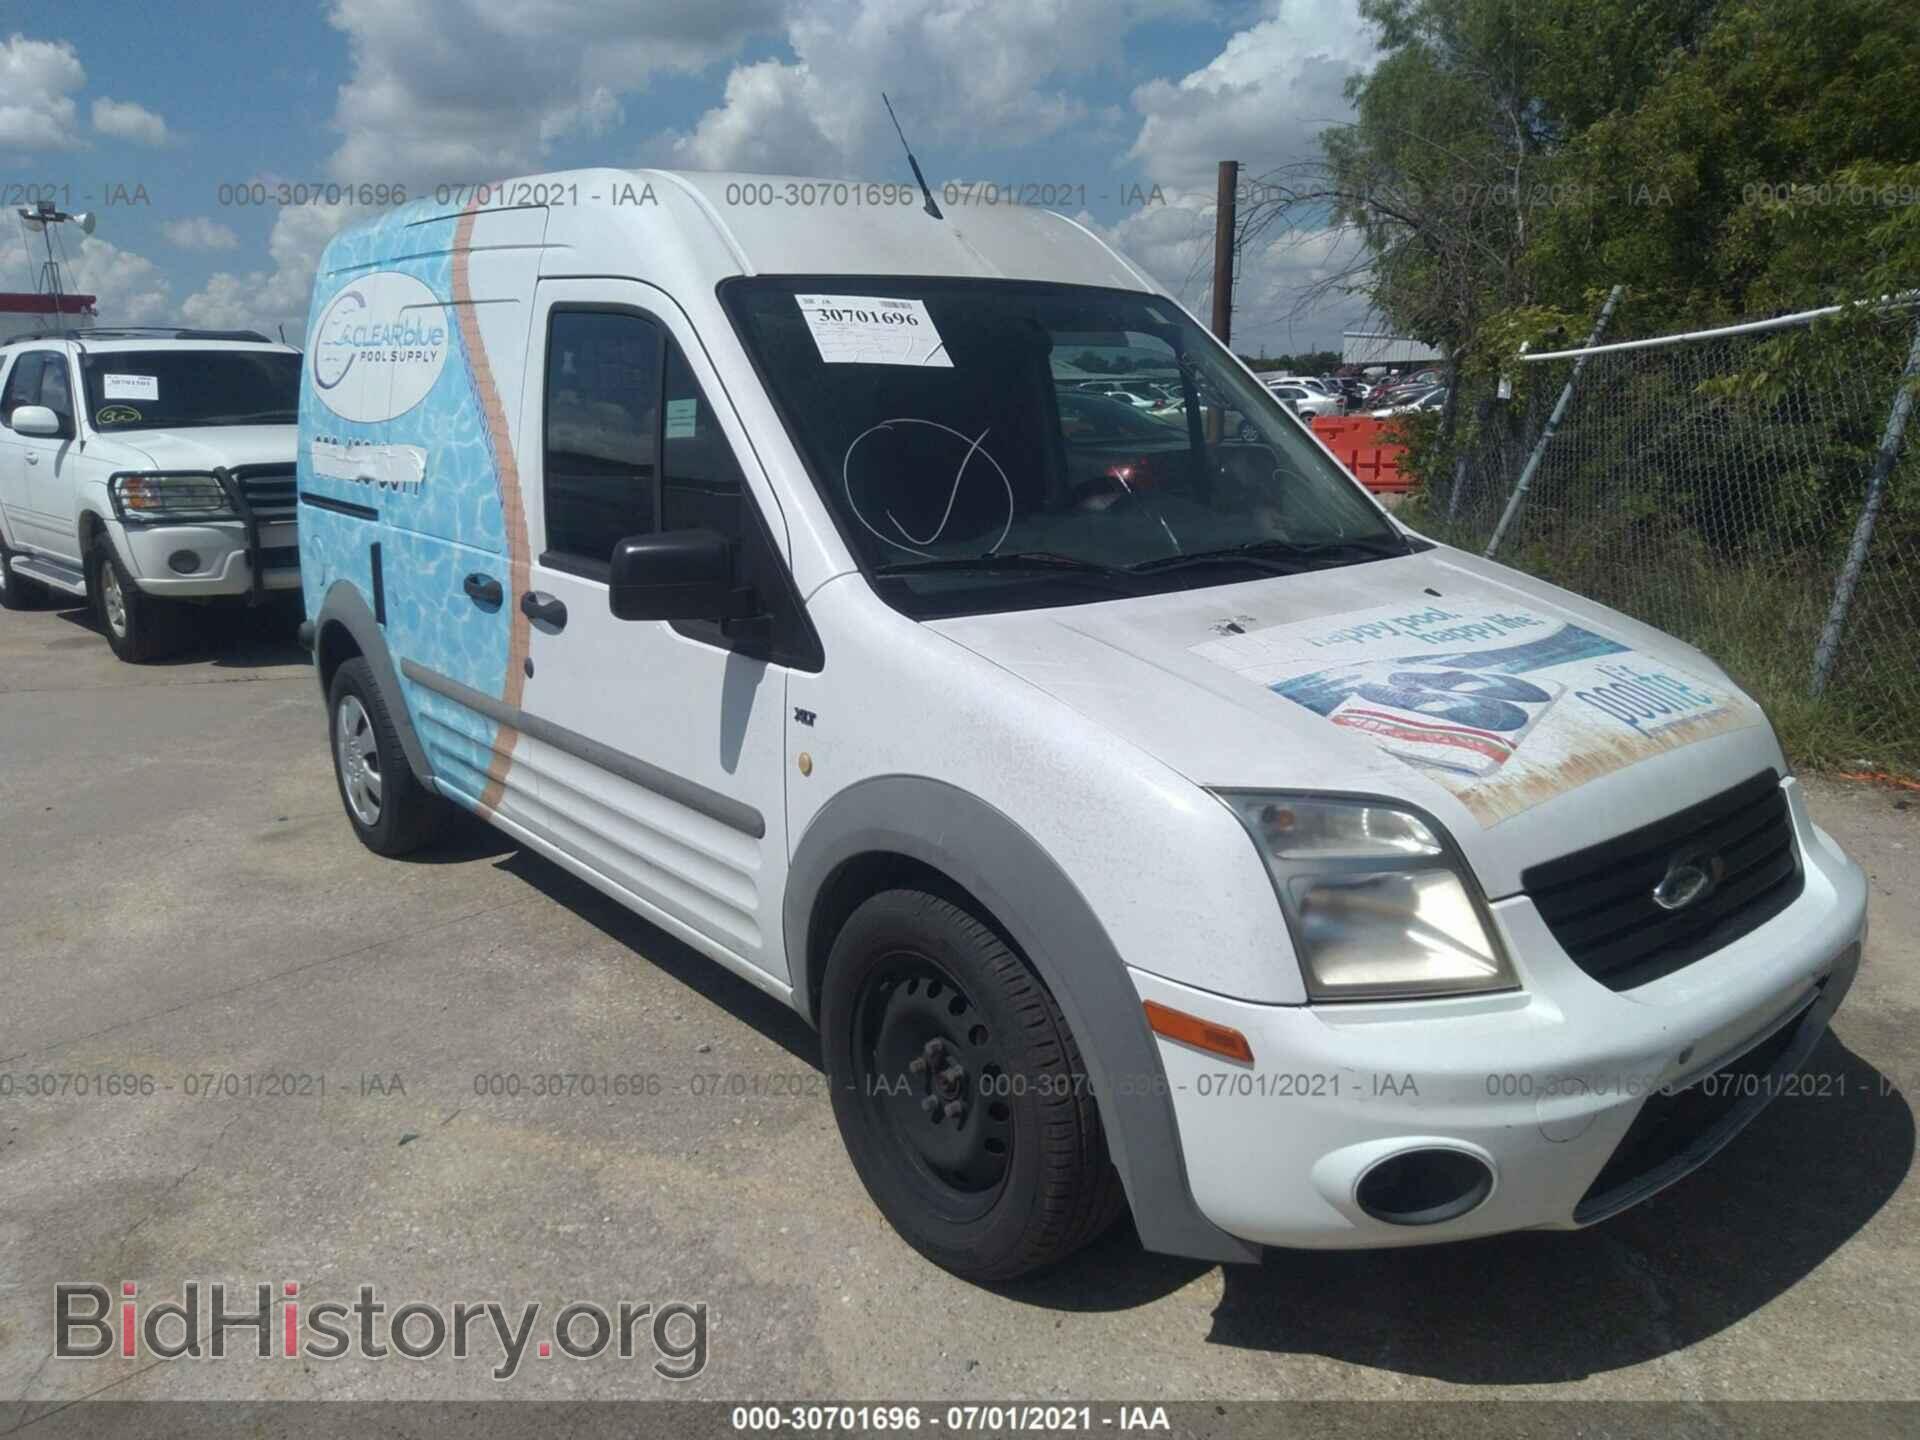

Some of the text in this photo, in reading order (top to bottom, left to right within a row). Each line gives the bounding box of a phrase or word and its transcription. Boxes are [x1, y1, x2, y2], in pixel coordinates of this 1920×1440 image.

[817, 308, 919, 326] 30701696
[360, 351, 437, 363] POOL SUPPLY
